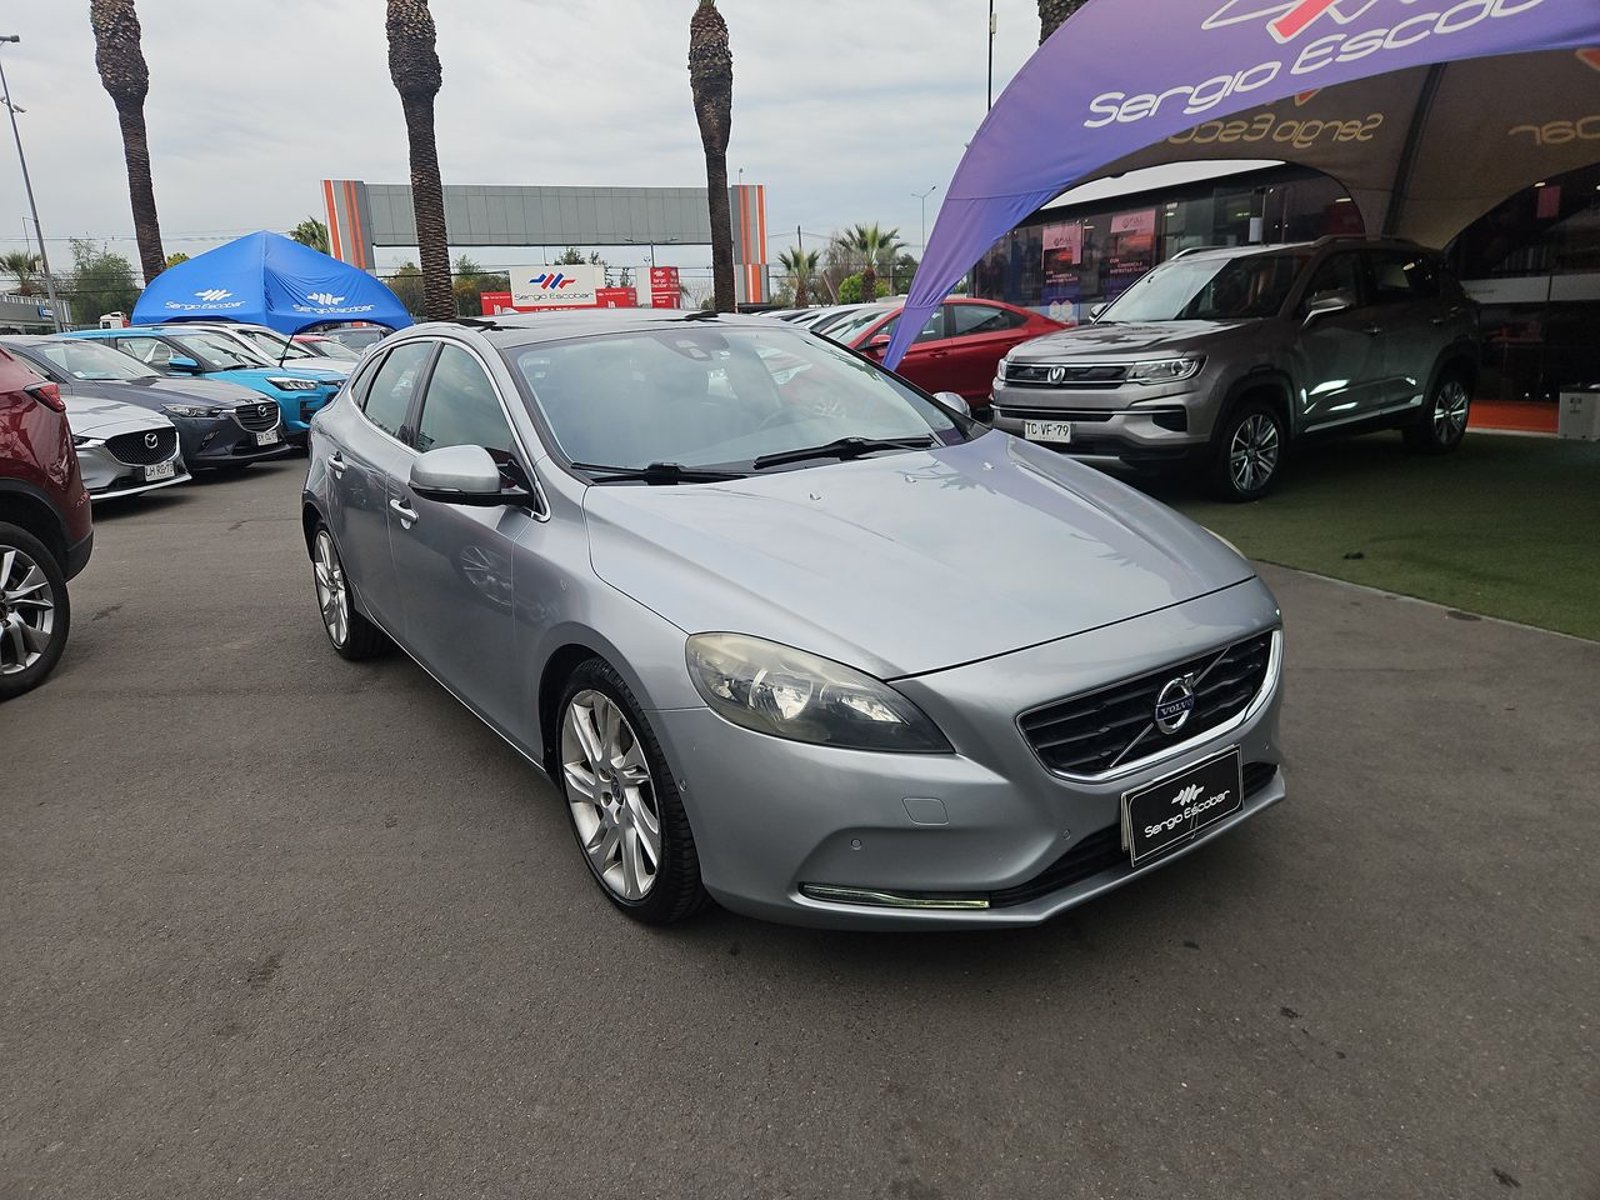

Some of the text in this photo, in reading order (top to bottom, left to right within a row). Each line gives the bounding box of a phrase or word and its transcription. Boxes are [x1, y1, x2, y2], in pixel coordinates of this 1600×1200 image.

[1084, 61, 1281, 128] Sergio
[1160, 698, 1192, 716] VOLVO
[1184, 790, 1231, 819] Escobar
